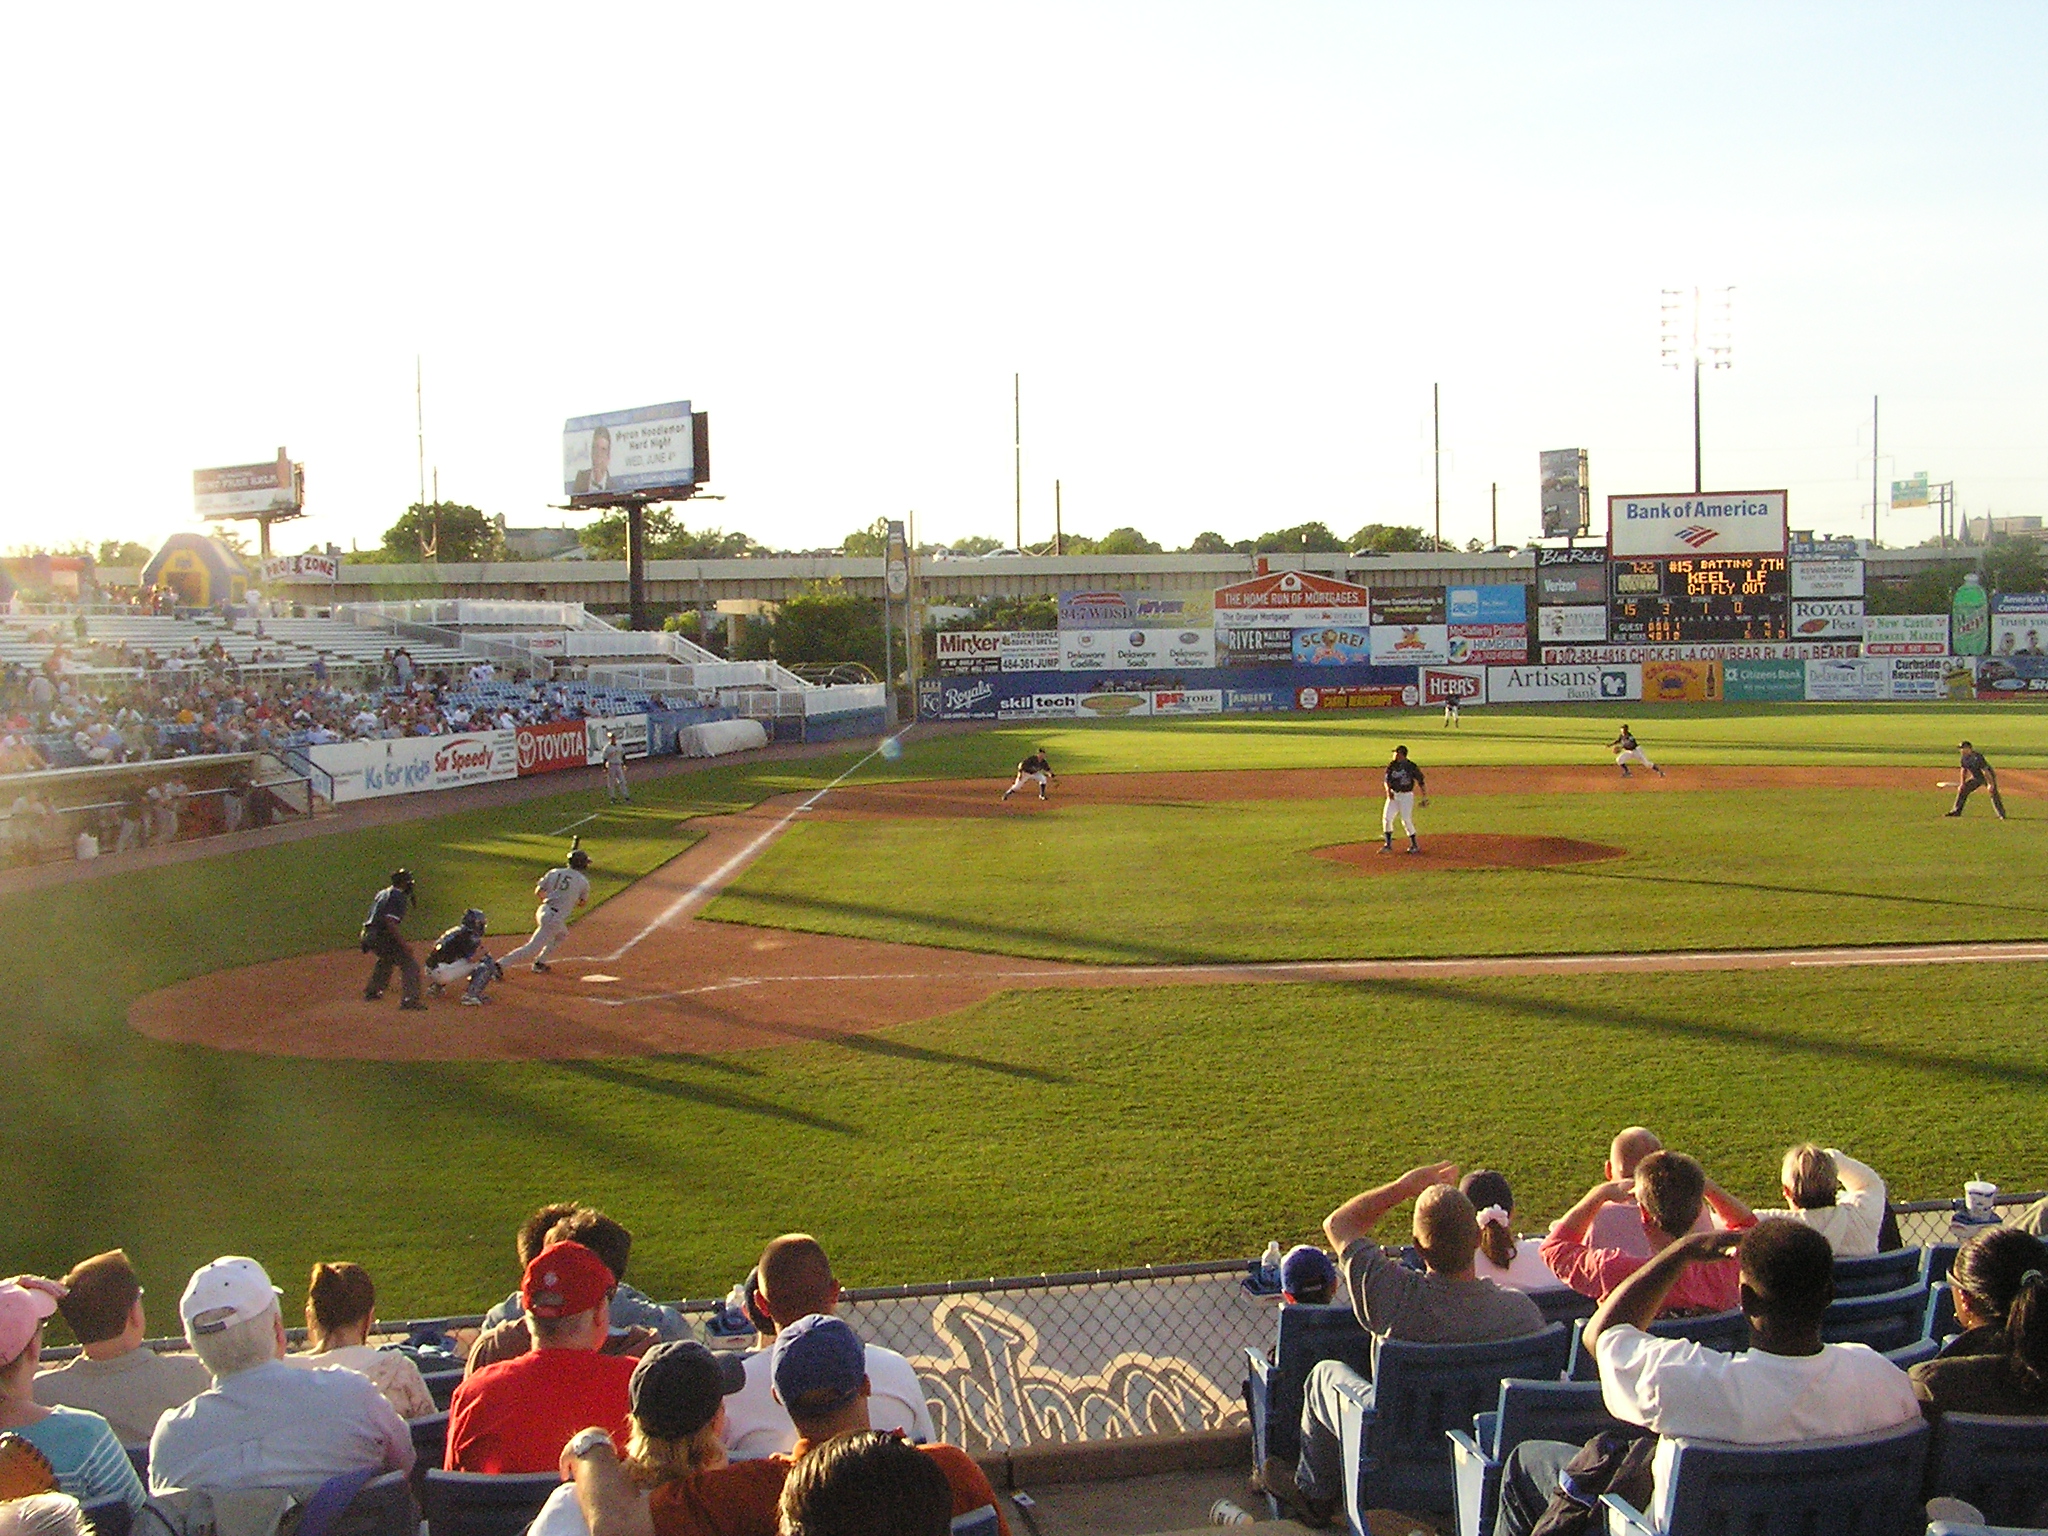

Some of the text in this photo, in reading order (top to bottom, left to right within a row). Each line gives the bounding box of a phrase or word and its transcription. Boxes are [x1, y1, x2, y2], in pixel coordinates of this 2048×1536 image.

[1627, 500, 1768, 520] Bank of America
[1541, 550, 1569, 565] Blue
[304, 557, 335, 577] ZONE
[1669, 559, 1785, 573] #15 BATTING 7TH
[1687, 570, 1768, 584] KEEL LF
[1711, 583, 1736, 595] FLY
[1742, 582, 1766, 594] OUT
[1225, 593, 1242, 605] THE
[1244, 593, 1269, 605] HOME
[1271, 592, 1290, 605] RUN
[1291, 592, 1303, 605] OF
[1305, 591, 1359, 604] MORTGAGES
[1624, 603, 1637, 615] 15
[1662, 603, 1671, 615] 3
[1704, 602, 1709, 614] 1
[1734, 602, 1742, 614] 0
[1796, 603, 1860, 616] ROYAL
[941, 634, 999, 653] Minker
[1230, 630, 1262, 649] RIVER
[1067, 651, 1106, 660] Delaware
[1117, 650, 1157, 659] Delaware
[1812, 645, 1845, 660] BEAR
[1070, 659, 1103, 668] Cadillac
[1127, 658, 1148, 667] Saab
[1175, 657, 1204, 667] Subaru
[1895, 660, 1941, 670] Curbside
[1507, 667, 1602, 688] Artisans'
[1892, 670, 1941, 680] Recycling
[1430, 678, 1476, 696] HERR'S
[1567, 688, 1598, 699] Bank
[945, 680, 993, 710] Royals
[1000, 696, 1076, 709] skil tech
[536, 731, 585, 762] TOYOTA
[450, 745, 494, 774] Speedy
[404, 757, 430, 787] Kids
[552, 873, 571, 891] 15
